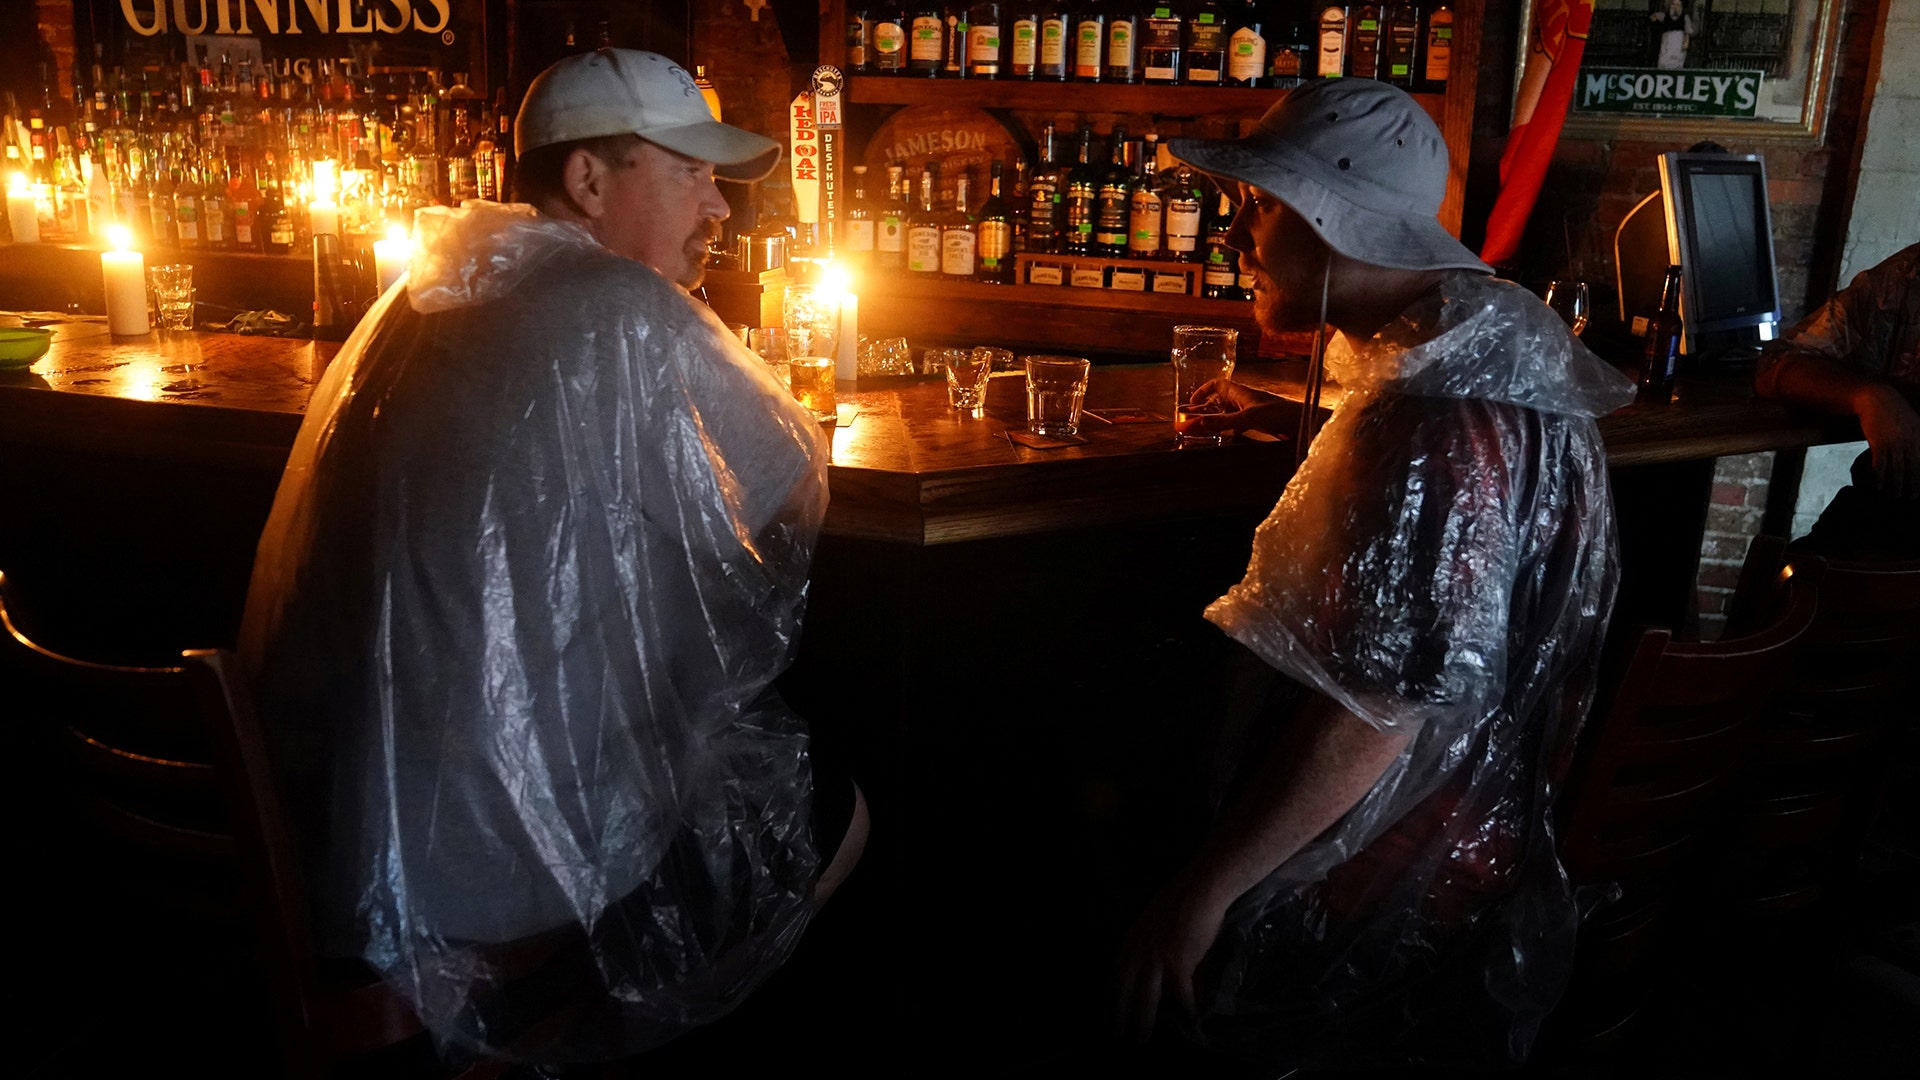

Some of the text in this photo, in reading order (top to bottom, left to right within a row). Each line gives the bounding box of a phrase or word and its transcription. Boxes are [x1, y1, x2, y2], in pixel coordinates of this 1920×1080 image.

[121, 0, 451, 36] GUINNESS
[819, 111, 837, 123] IPA
[794, 143, 818, 181] OAK
[884, 129, 986, 168] JAMESON
[824, 133, 835, 219] DESCHUTES
